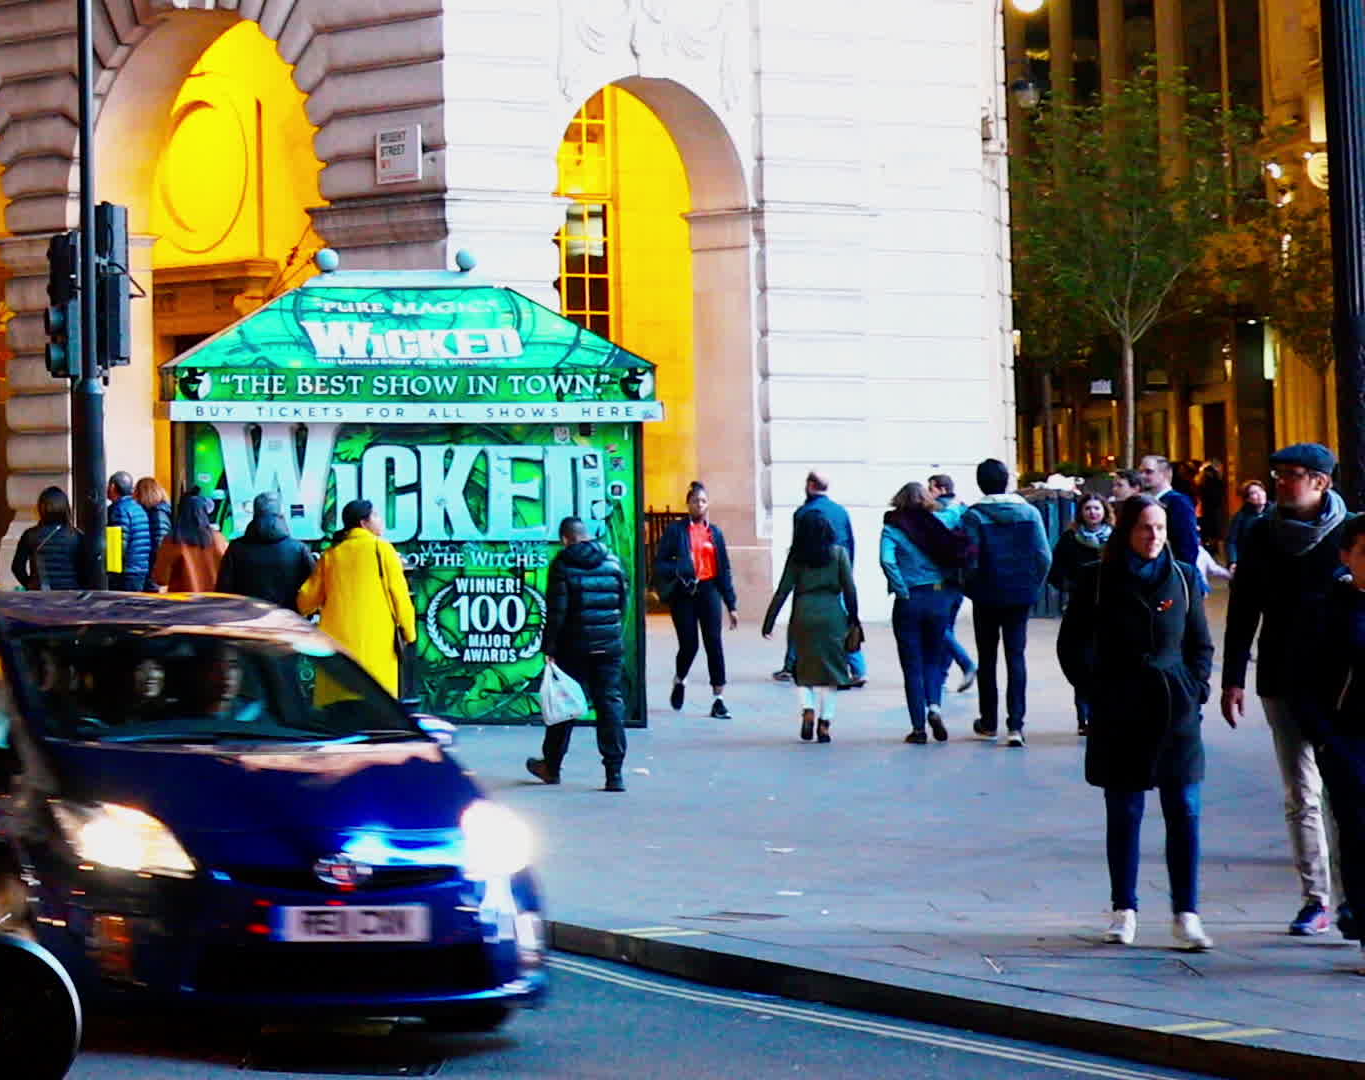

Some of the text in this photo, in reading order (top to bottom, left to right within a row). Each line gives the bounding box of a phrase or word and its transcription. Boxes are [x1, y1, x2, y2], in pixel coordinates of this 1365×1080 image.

[302, 321, 523, 358] WICKED
[220, 376, 286, 395] "THE
[296, 376, 365, 395] BEST
[372, 376, 459, 395] SHOW
[468, 376, 498, 395] IN
[195, 406, 234, 417] BUY
[256, 406, 344, 417] TICKETS
[366, 406, 406, 417] FOR
[428, 406, 465, 417] ALL
[485, 406, 560, 418] SHOWS
[581, 406, 635, 418] HERE
[214, 423, 607, 542] WICKED
[433, 551, 466, 568] THE
[470, 551, 550, 569] WITCHES
[456, 577, 522, 594] WINNER!
[452, 594, 527, 633] 100
[467, 633, 512, 649] MAJOR
[462, 648, 518, 663] AWARDS
